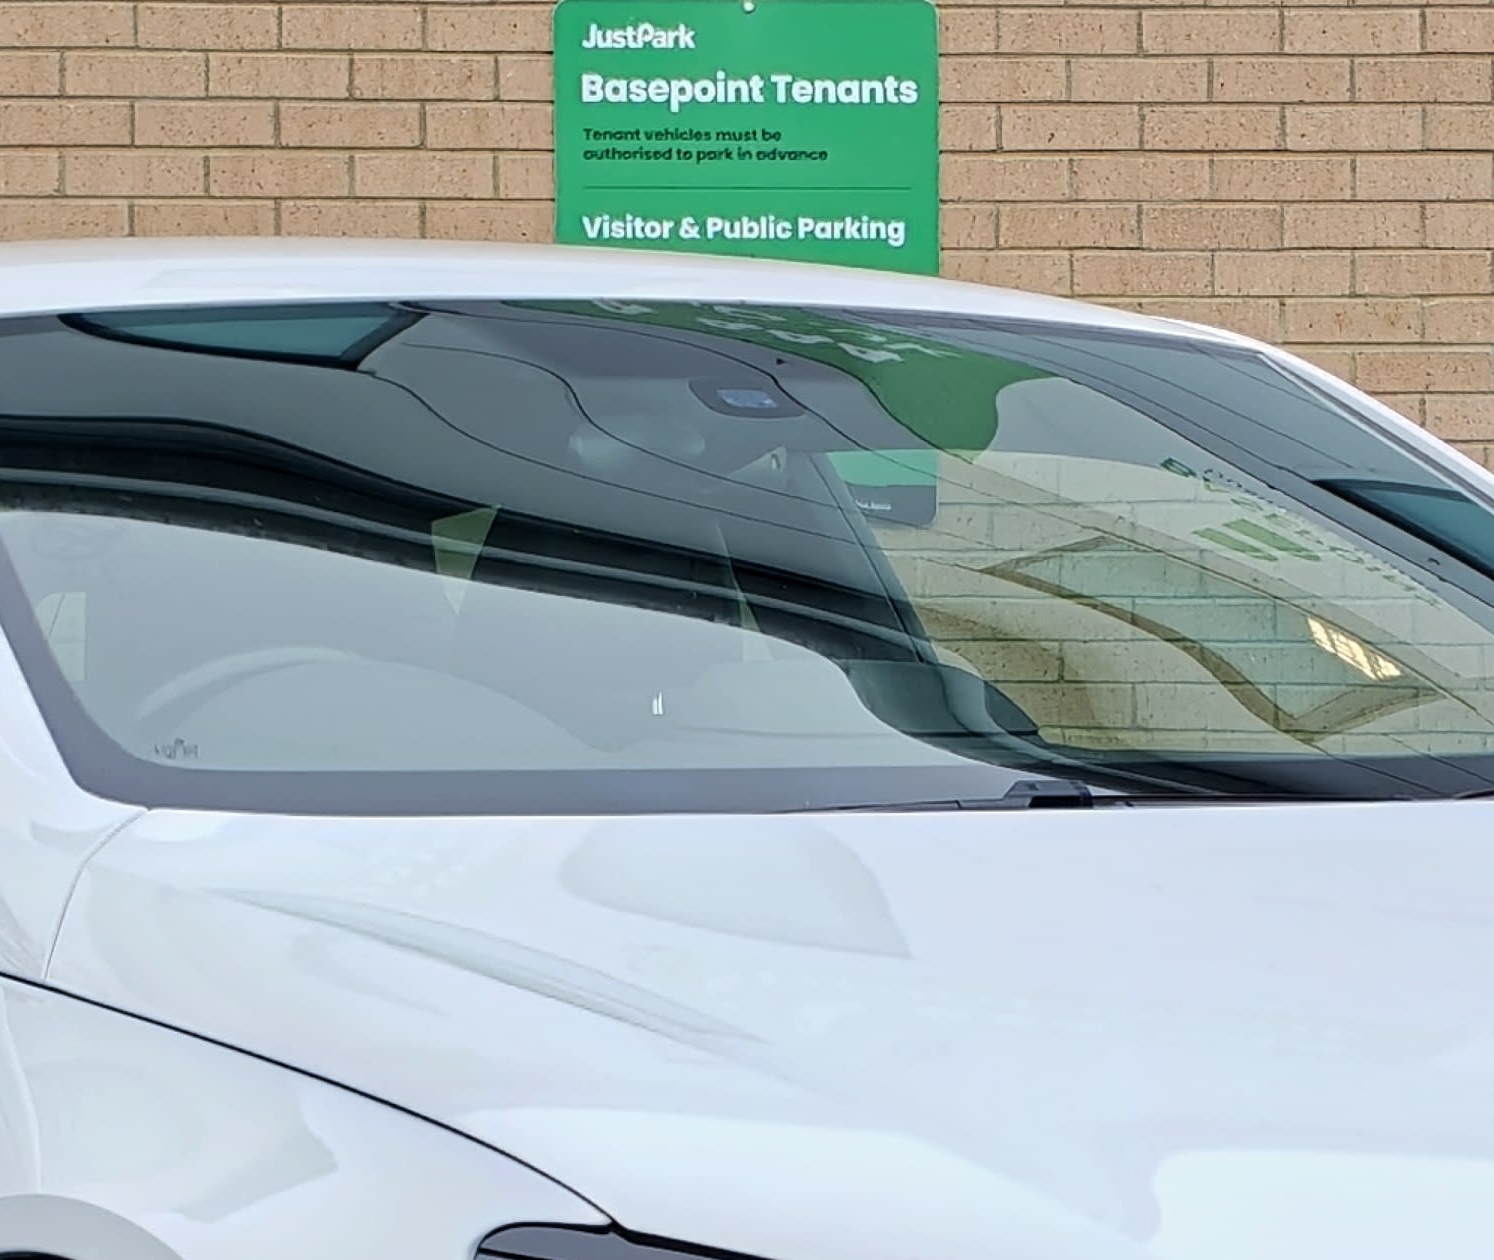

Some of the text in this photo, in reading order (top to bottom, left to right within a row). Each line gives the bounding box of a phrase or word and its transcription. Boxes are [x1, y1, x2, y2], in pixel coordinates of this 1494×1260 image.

[582, 22, 696, 49] JustPark
[581, 70, 919, 113] Basepoint Tenants
[583, 127, 782, 142] Tenant vehicles must be
[582, 146, 829, 164] authorised to park in advance
[582, 213, 906, 248] Visitor & Public Parking
